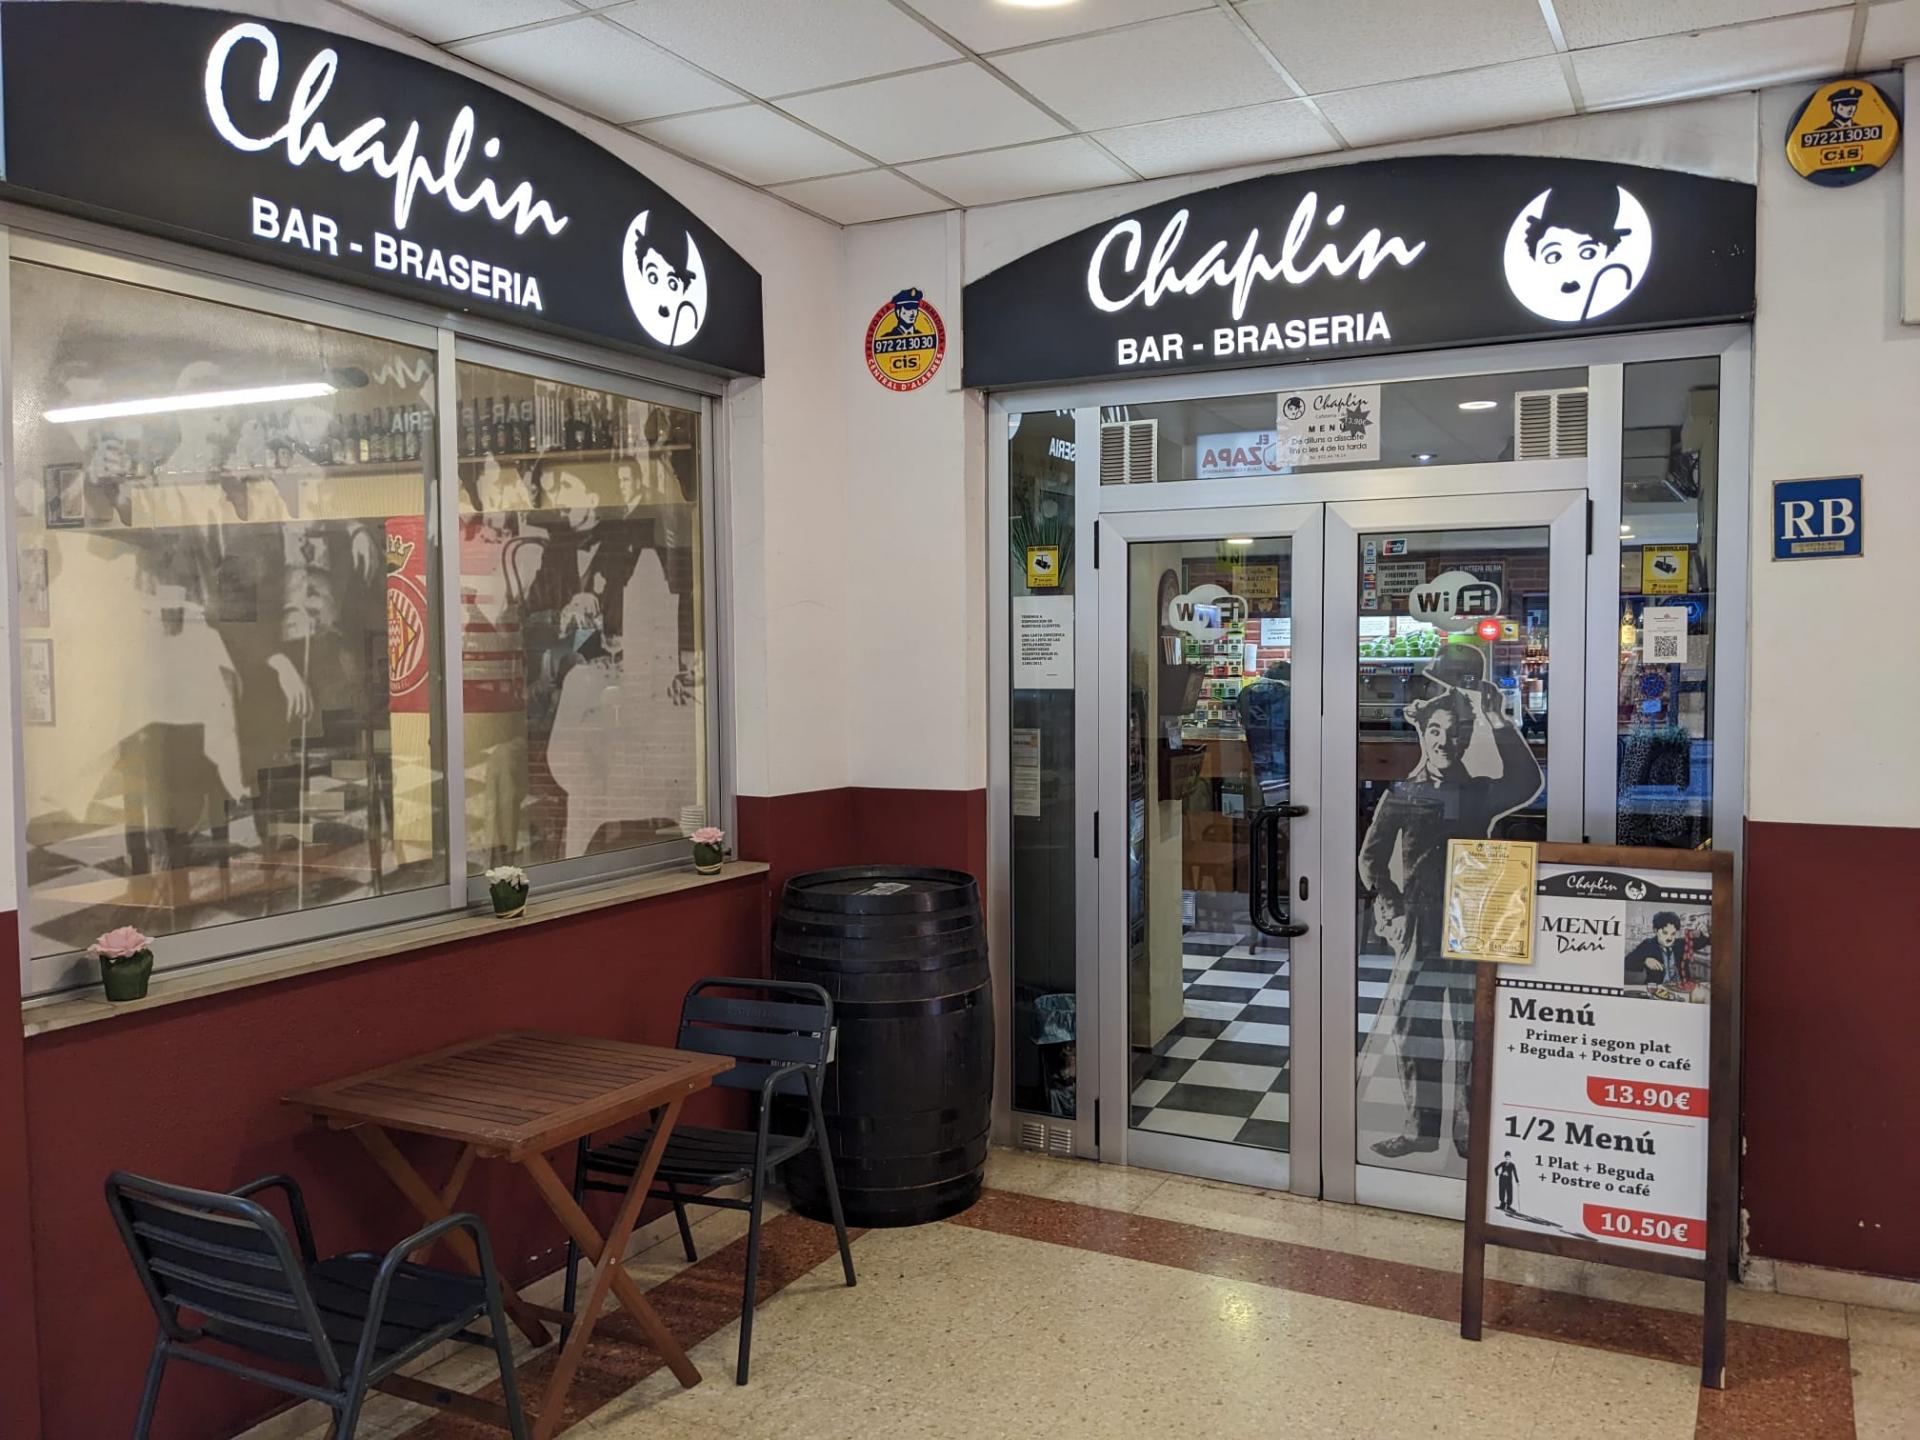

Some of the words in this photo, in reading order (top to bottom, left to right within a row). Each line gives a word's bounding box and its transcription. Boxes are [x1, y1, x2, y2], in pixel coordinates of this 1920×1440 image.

[205, 23, 568, 235] Chaplin
[253, 197, 339, 256] BAR
[374, 232, 543, 311] BRASERIA
[1088, 192, 1425, 320] Chaplin
[1118, 334, 1183, 366] BAR
[1214, 312, 1391, 357] BRASERIA
[1313, 392, 1368, 412] Chaplin
[1781, 498, 1855, 539] RB
[1567, 875, 1617, 893] Chaplin
[1540, 916, 1621, 936] MENÚ
[1556, 934, 1606, 954] Diari
[1508, 996, 1596, 1027] Menú
[1526, 1028, 1579, 1045] Primer
[1581, 1034, 1587, 1046] i
[1590, 1037, 1636, 1052] segon
[1639, 1040, 1672, 1055] plat
[1519, 1042, 1575, 1060] Beguda
[1591, 1049, 1642, 1067] Postre
[1645, 1058, 1655, 1067] o
[1658, 1056, 1692, 1071] café
[1604, 1084, 1691, 1111] 13.90€
[1503, 1115, 1555, 1143] 1/2
[1564, 1121, 1656, 1156] Menú
[1535, 1155, 1543, 1167] 1
[1548, 1156, 1580, 1171] Plat
[1597, 1162, 1655, 1182] Beguda
[1551, 1172, 1601, 1190] Postre
[1604, 1182, 1614, 1192] o
[1618, 1182, 1651, 1197] café
[1601, 1213, 1688, 1242] 10.50€
